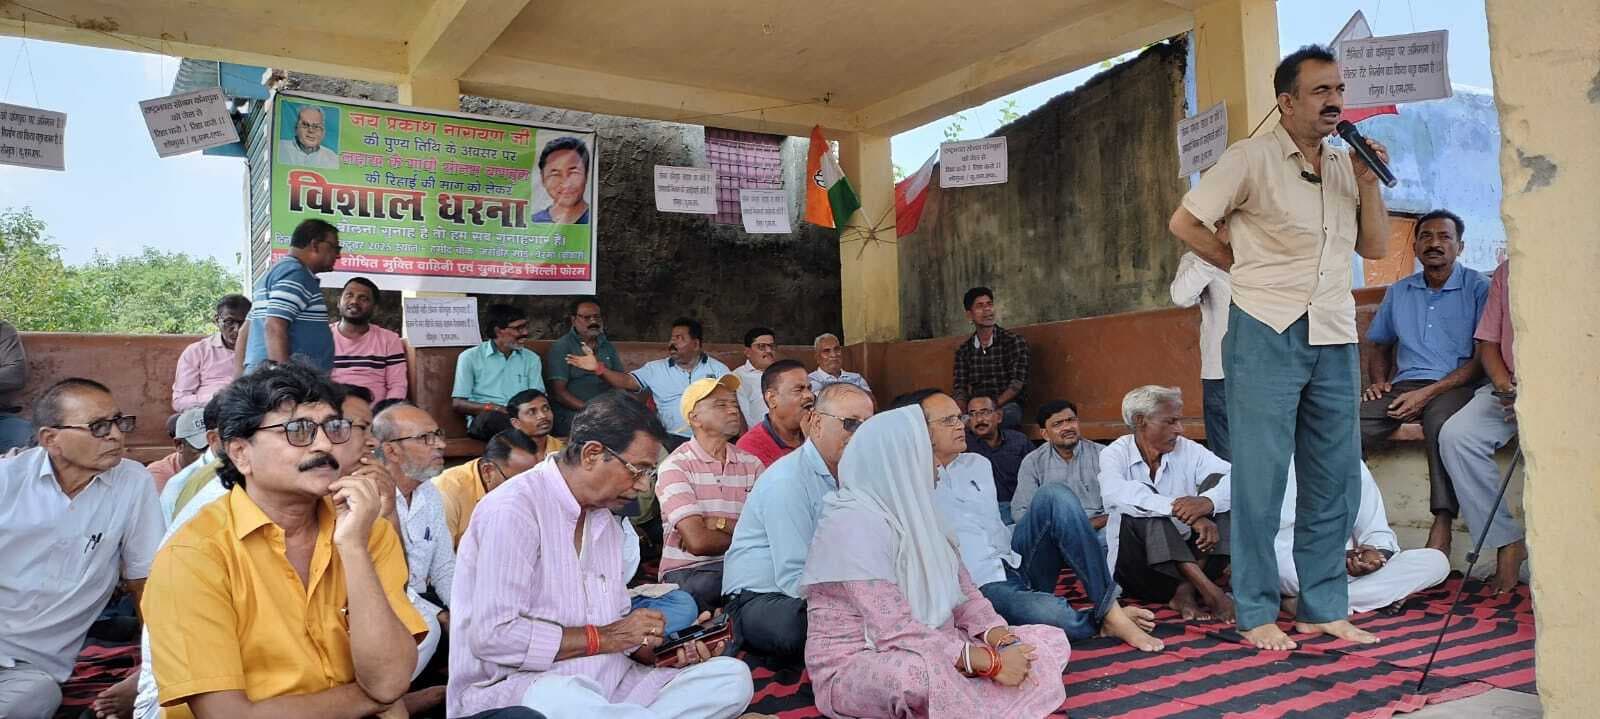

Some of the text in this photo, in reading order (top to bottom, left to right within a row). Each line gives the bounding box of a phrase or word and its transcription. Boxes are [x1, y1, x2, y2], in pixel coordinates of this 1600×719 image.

[349, 112, 531, 146] जय प्रकाश नारायण जी
[363, 132, 517, 162] की पुण्य तिथि के अवसर पर
[364, 169, 380, 185] की
[385, 171, 417, 190] रिहाई
[421, 175, 436, 189] की
[467, 181, 481, 193] को
[485, 181, 513, 195] लेकर
[288, 169, 529, 229] विशाल धरना
[336, 219, 377, 235] बोलना
[381, 225, 416, 240] गुनाह
[420, 224, 429, 240] है
[432, 226, 447, 241] तो
[450, 230, 468, 241] हम
[471, 231, 491, 242] सब
[496, 232, 550, 247] गुनाहगार
[340, 253, 378, 269] शोषित
[383, 256, 413, 272] मुक्ति
[417, 257, 454, 272] वाहिनी
[457, 261, 474, 272] एवं
[526, 263, 558, 276] मिल्ली
[559, 264, 585, 276] फोरम
